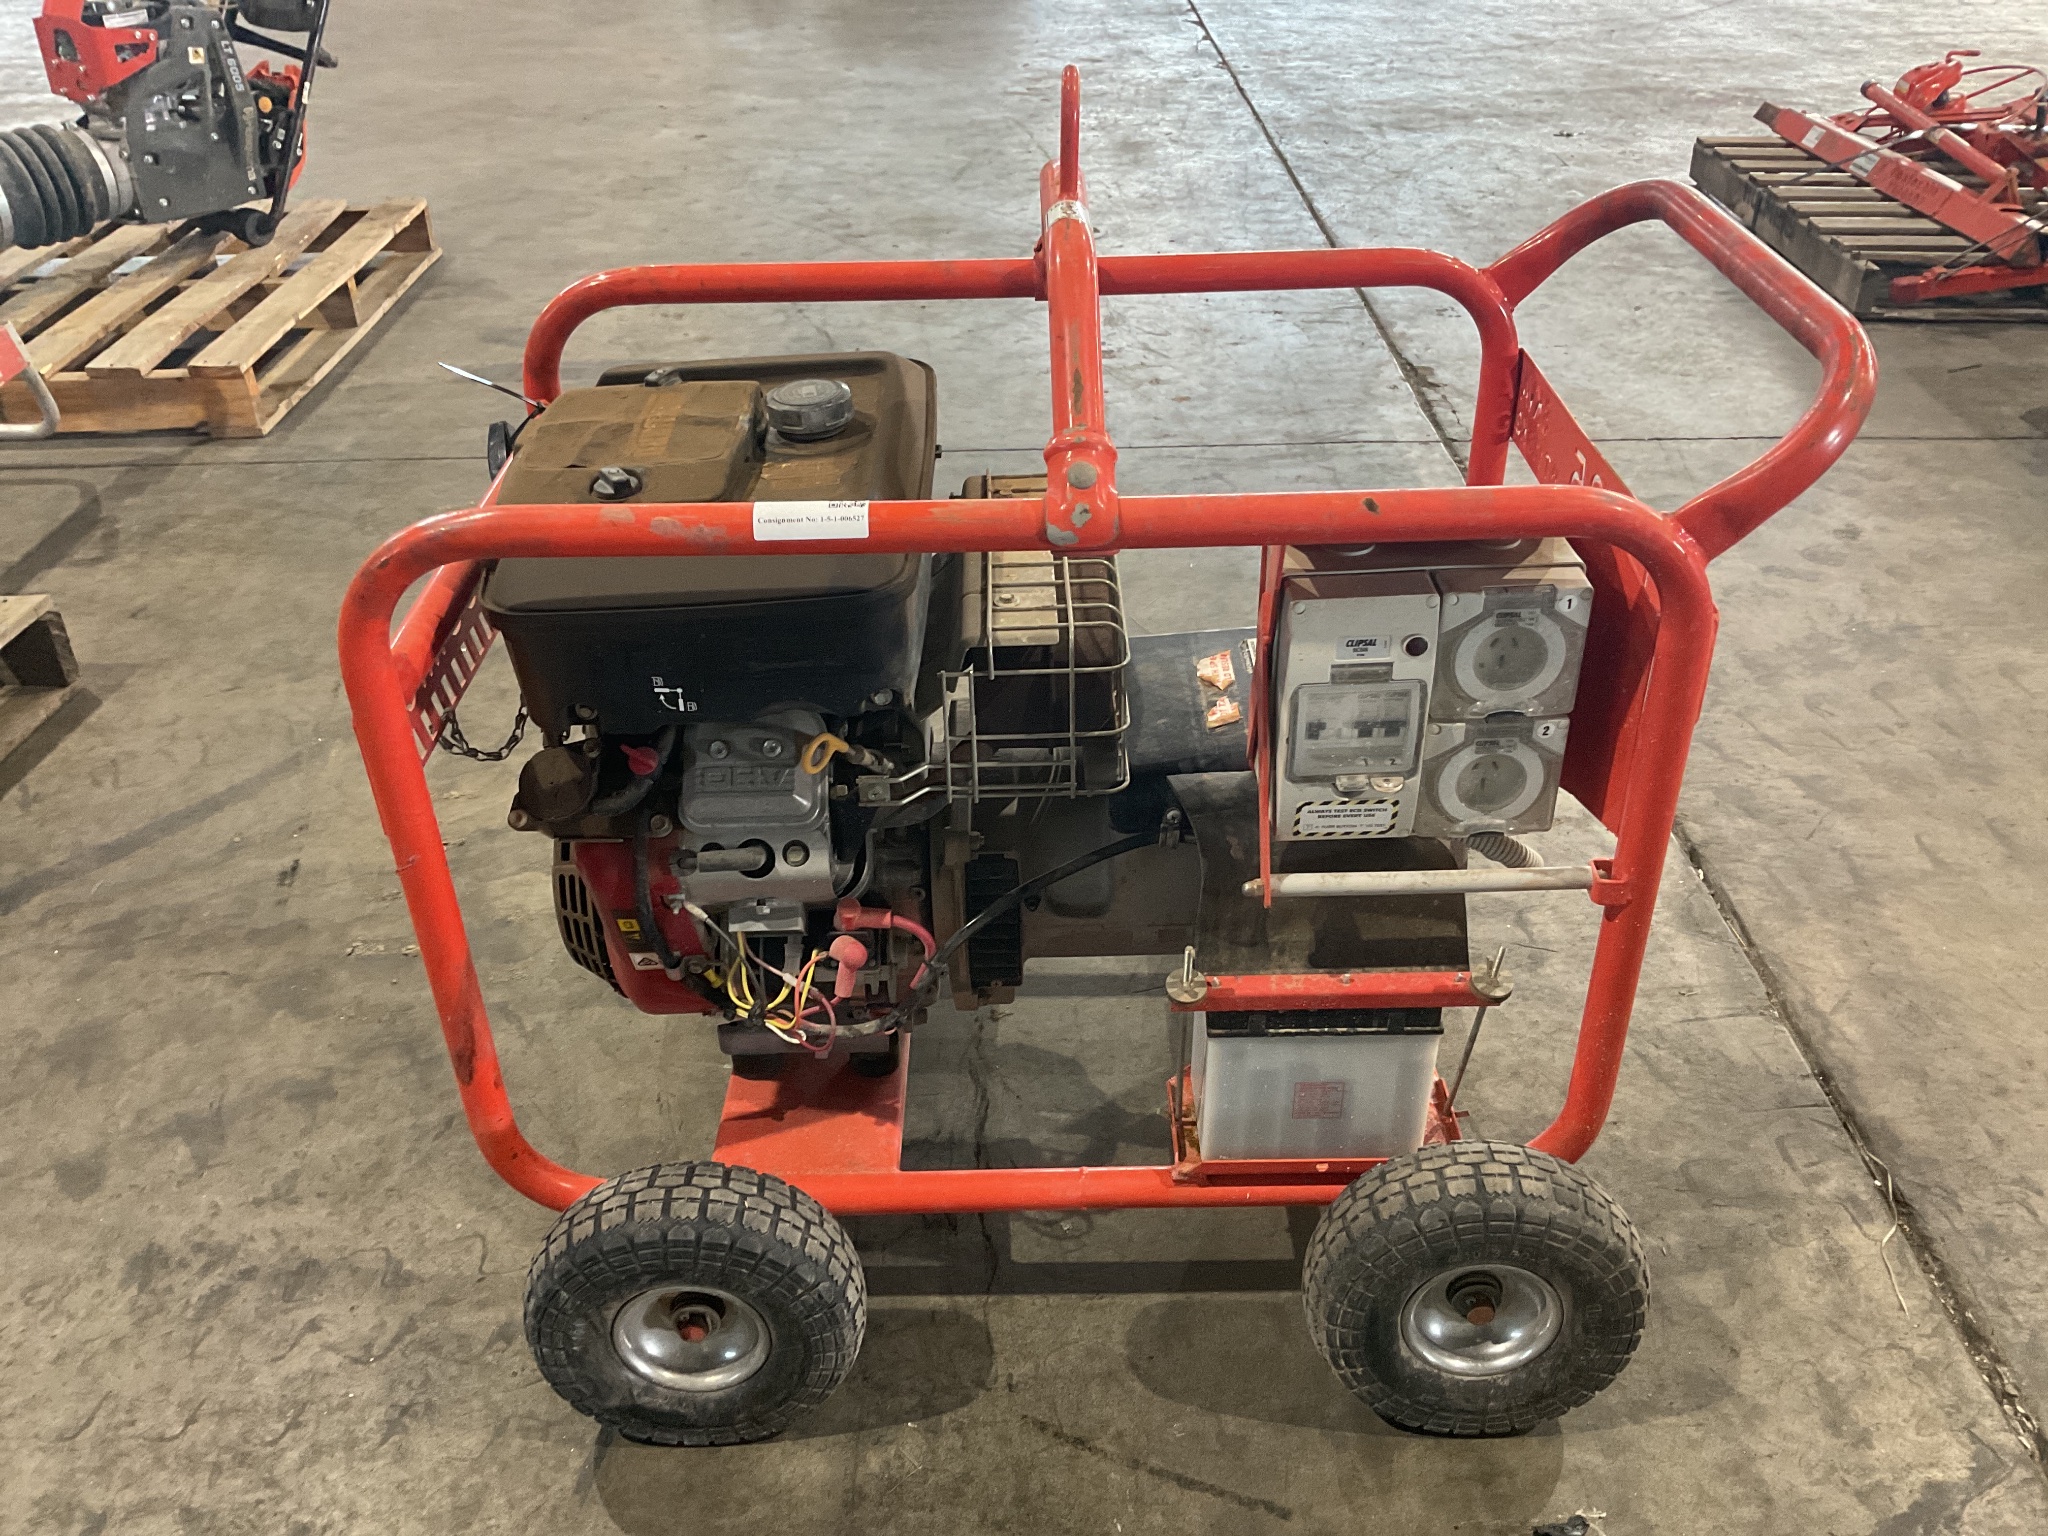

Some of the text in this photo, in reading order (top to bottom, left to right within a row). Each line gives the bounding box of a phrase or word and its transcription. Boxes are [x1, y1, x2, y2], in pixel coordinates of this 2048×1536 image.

[220, 40, 245, 91] LT 6005
[757, 516, 804, 525] Consignment
[1567, 598, 1573, 610] 1
[1345, 639, 1377, 647] CLIPSAL
[1541, 725, 1550, 736] 2
